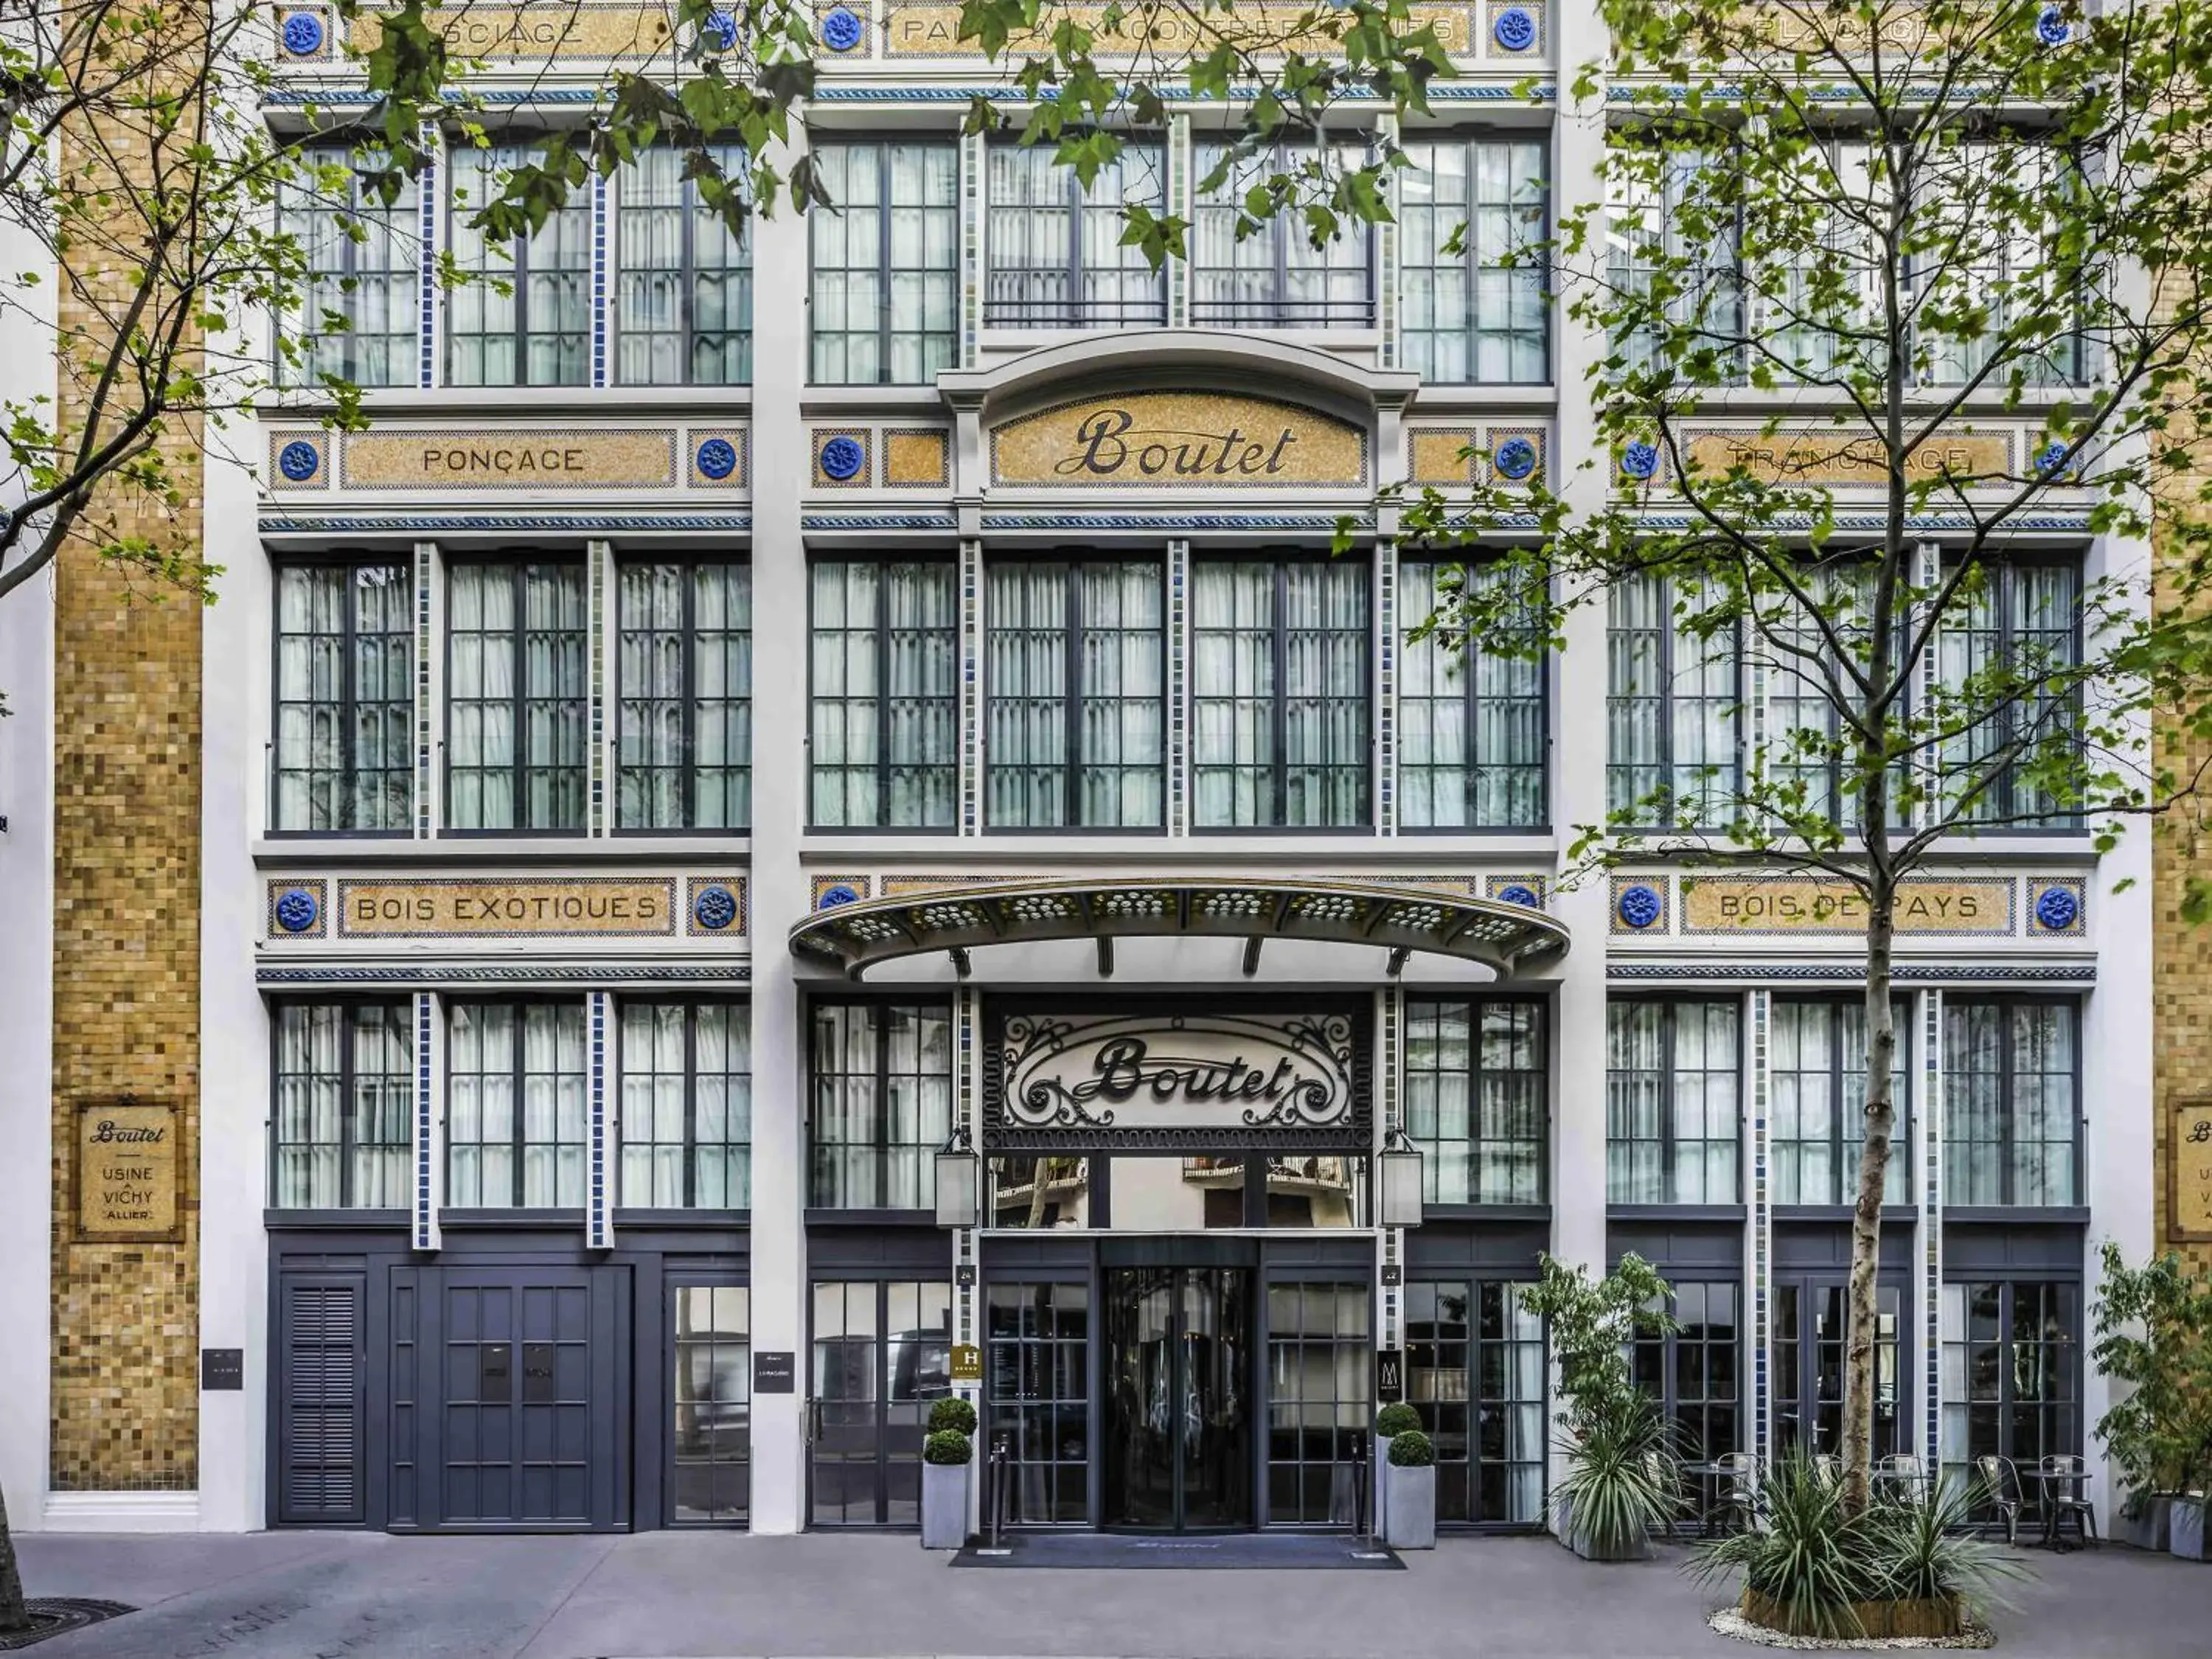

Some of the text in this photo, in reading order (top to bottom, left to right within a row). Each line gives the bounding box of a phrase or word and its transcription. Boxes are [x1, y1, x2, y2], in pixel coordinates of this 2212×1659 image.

[1054, 408, 1298, 475] Boutet
[424, 449, 583, 473] PONÇAGE
[358, 897, 655, 919] BOIS EXOTIQUES
[1721, 896, 1798, 917] BOIS
[1818, 895, 1859, 916] DE
[1071, 1038, 1293, 1100] Boutet
[90, 1120, 166, 1143] Boutet
[102, 1168, 153, 1180] USINE
[103, 1192, 153, 1204] VICHY
[965, 1352, 978, 1364] H
